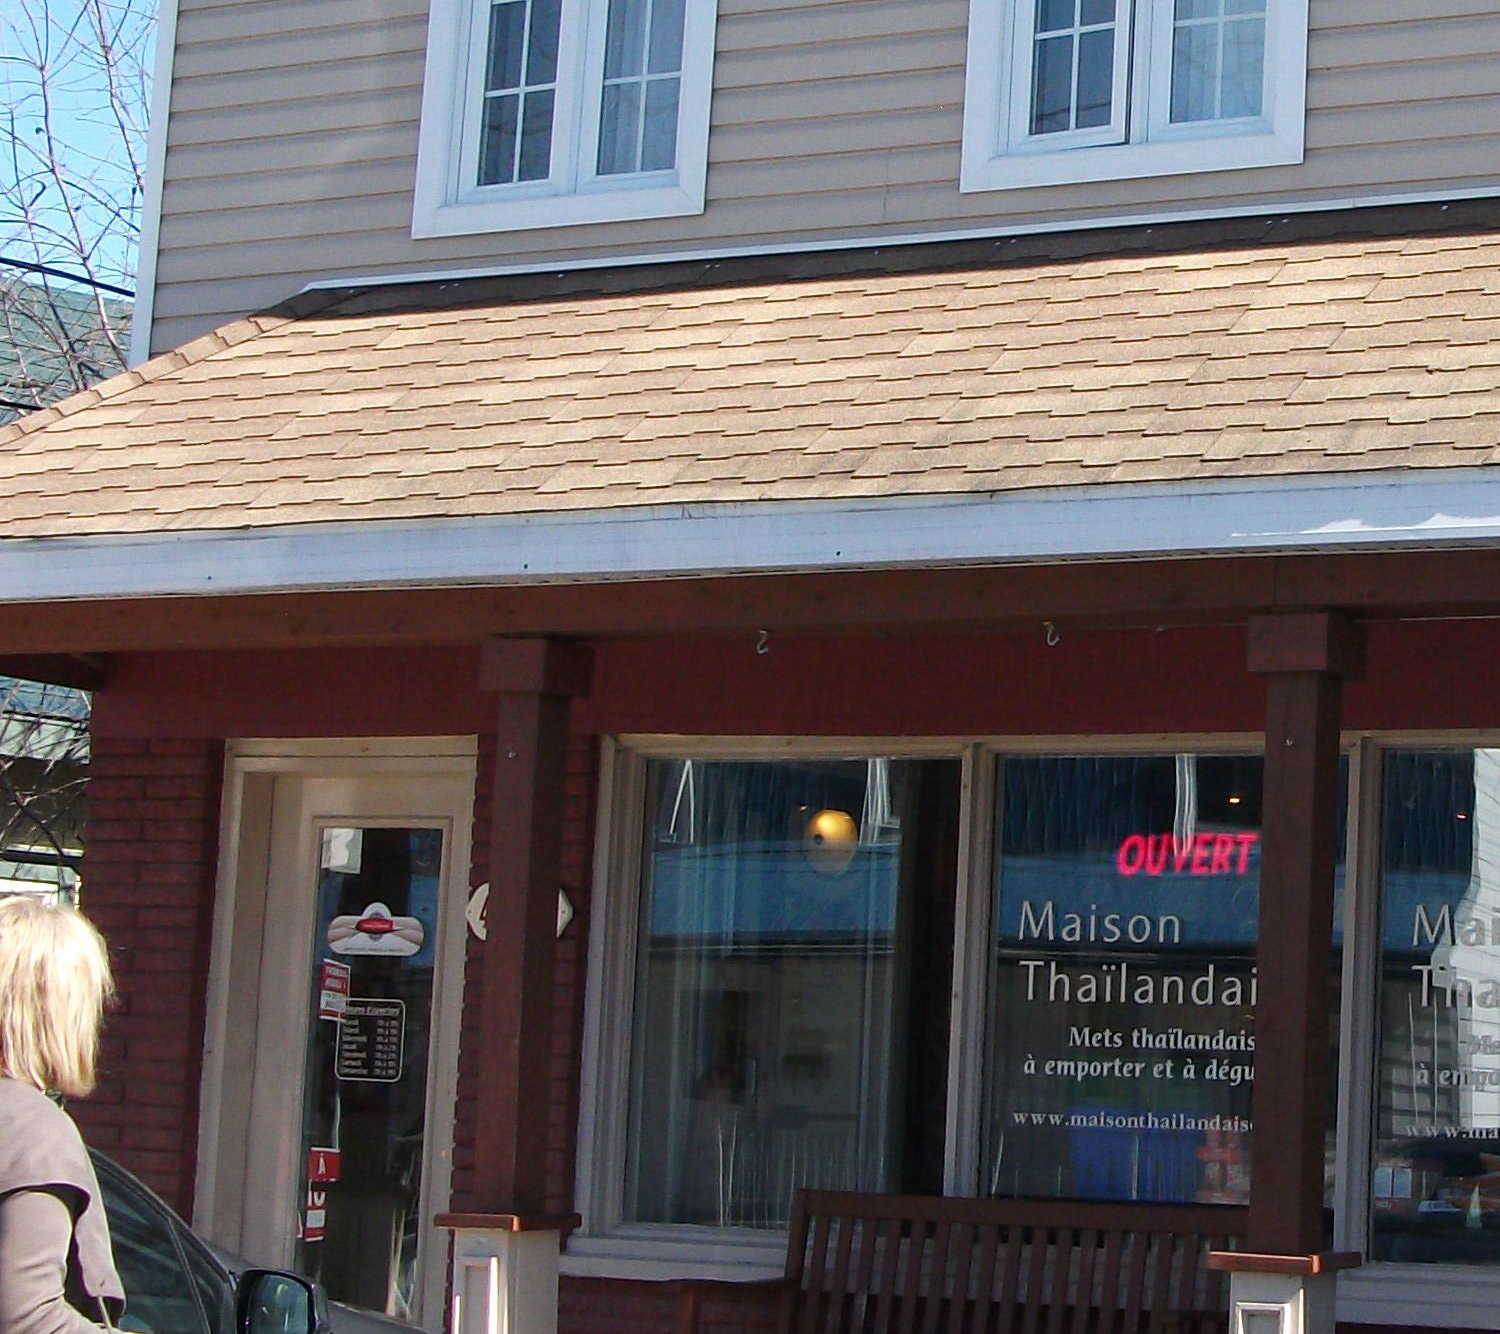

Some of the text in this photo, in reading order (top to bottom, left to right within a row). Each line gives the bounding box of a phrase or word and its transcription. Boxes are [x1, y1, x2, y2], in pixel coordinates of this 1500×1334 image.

[1117, 832, 1257, 877] OUVERT
[1018, 900, 1181, 943] Maison
[1018, 960, 1258, 1006] Thaïlandai
[1069, 1026, 1255, 1051] Mets thaïlandais
[1024, 1054, 1255, 1086] à emporter et à dégu
[1416, 1063, 1428, 1085] à
[1012, 1110, 1253, 1133] www.maisonthailandais
